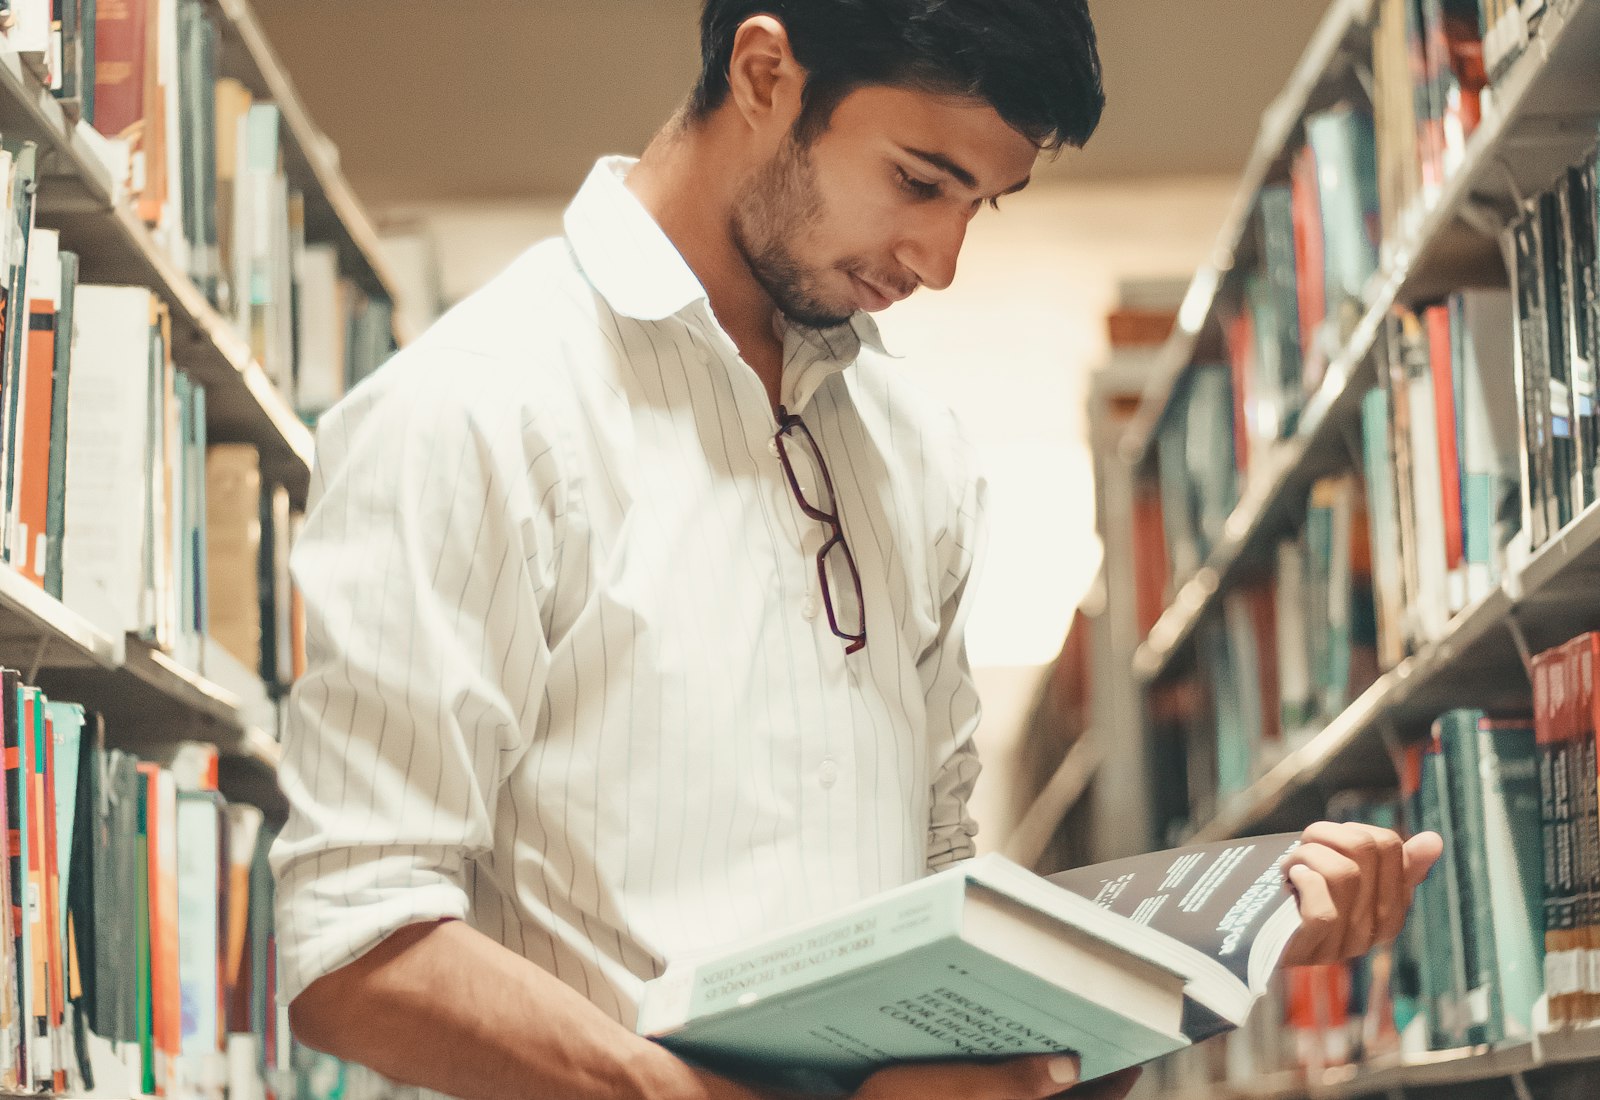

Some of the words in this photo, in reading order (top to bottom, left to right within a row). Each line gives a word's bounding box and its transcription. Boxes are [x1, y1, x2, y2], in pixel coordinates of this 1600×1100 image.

[807, 925, 851, 949] DIGITAL
[854, 917, 877, 934] FOR
[896, 1000, 935, 1018] FOR
[935, 1017, 1004, 1051] DIGITAL
[916, 993, 1024, 1046] TECHNIQUES
[934, 987, 1074, 1052] ERROR-CONTRO
